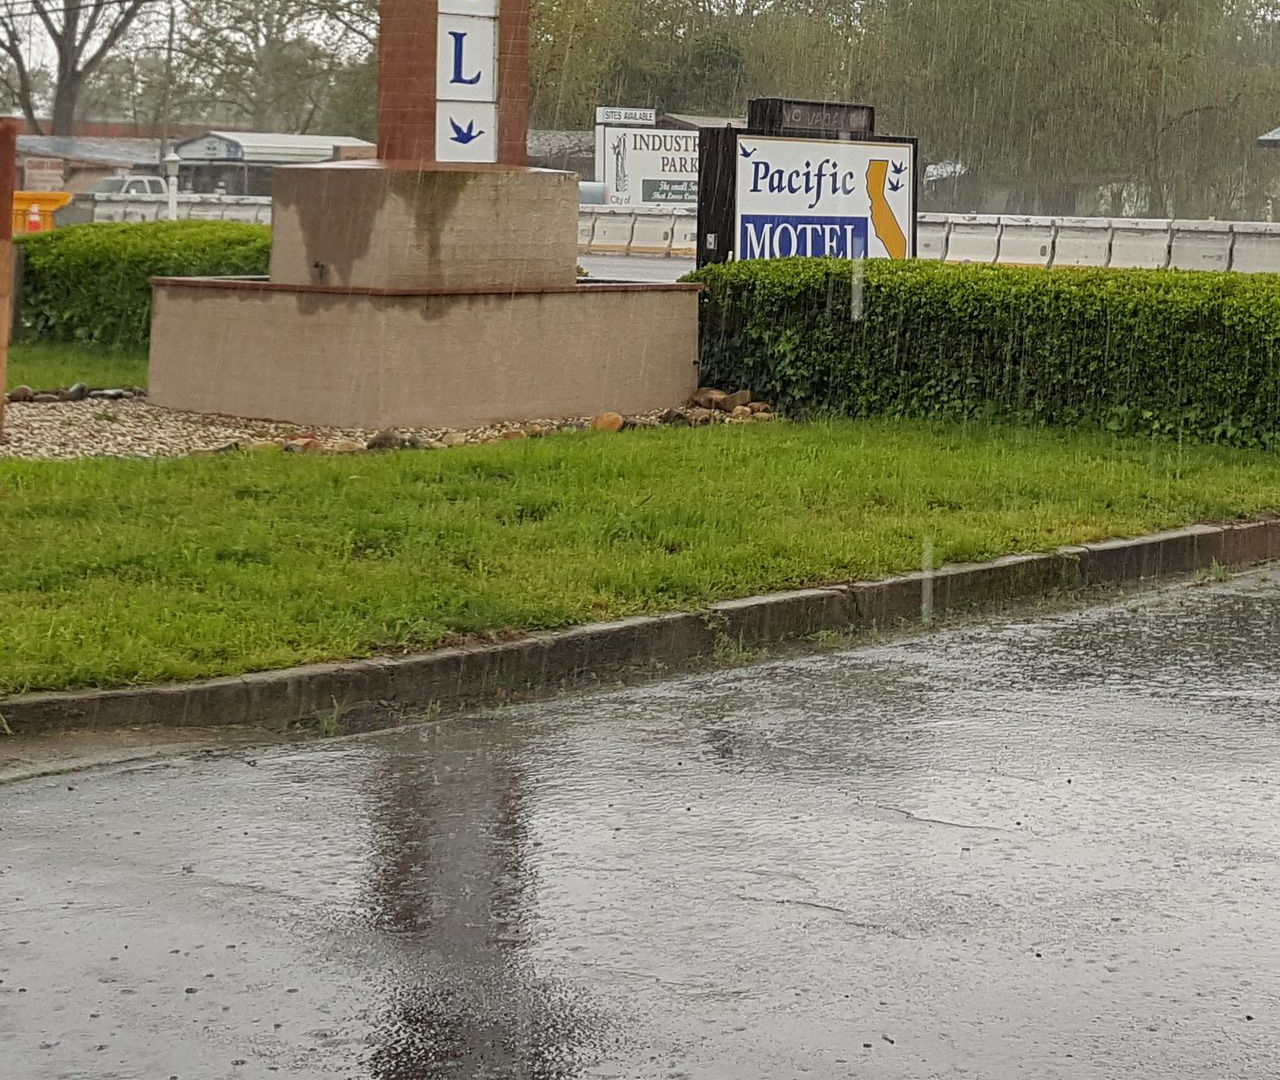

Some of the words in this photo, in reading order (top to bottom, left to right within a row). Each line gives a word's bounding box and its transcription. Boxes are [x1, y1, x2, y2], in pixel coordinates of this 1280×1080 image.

[605, 110, 621, 120] SITES
[624, 112, 653, 121] AVAILABLE
[632, 134, 699, 152] INDUSTR
[661, 157, 698, 173] PARK
[749, 159, 856, 209] Pacific
[745, 223, 865, 261] MOTEL
